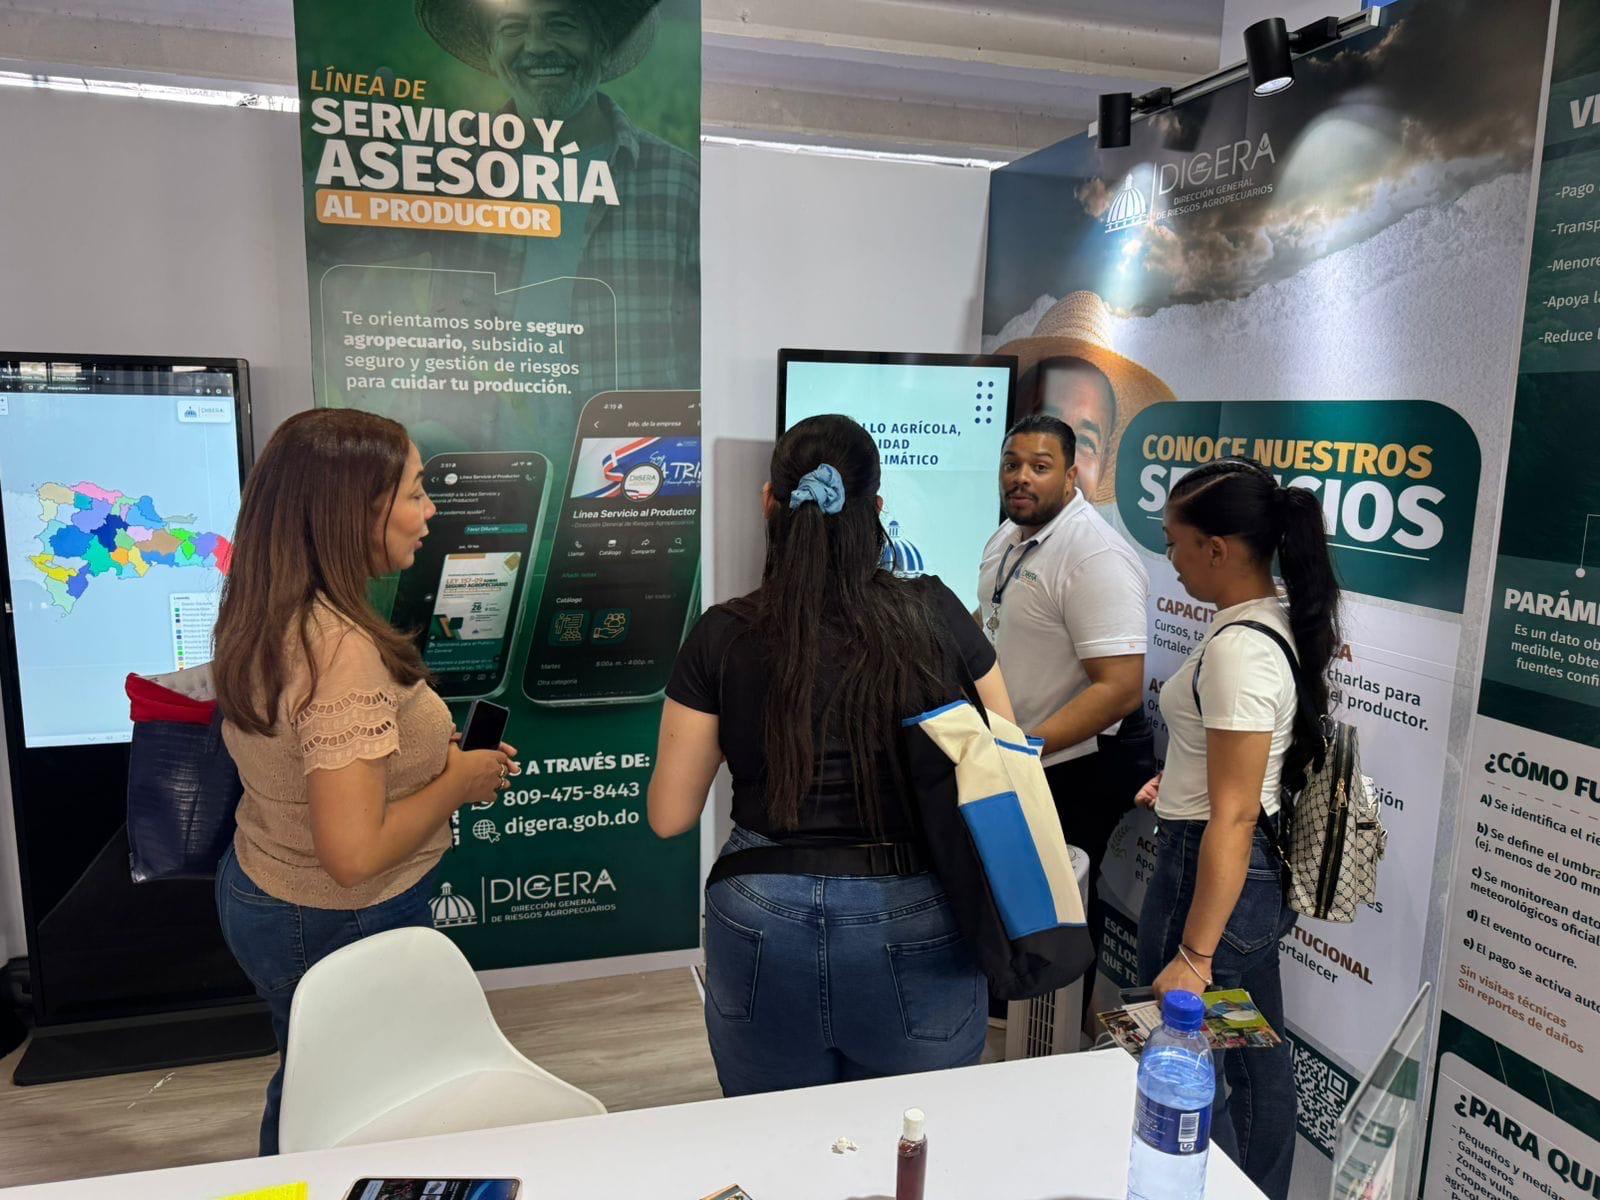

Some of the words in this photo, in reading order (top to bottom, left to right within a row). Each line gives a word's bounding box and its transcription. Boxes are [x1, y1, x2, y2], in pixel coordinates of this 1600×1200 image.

[310, 66, 386, 97] LÍNEA
[394, 78, 427, 100] DE
[311, 97, 526, 150] SERVICIO
[533, 118, 564, 153] Y
[315, 139, 620, 206] ASESORÍA
[1158, 132, 1276, 196] DIGERA
[1156, 210, 1168, 220] DE
[1168, 202, 1201, 217] RIESGOS
[1202, 183, 1274, 209] AGROPECUARIOS
[1173, 187, 1214, 206] DIRECCIÓN
[1216, 178, 1255, 195] GENERAL
[1556, 183, 1594, 199] -Pago
[323, 194, 361, 220] AL
[370, 198, 551, 231] PRODUCTOR
[1542, 293, 1589, 310] -Apoya
[342, 310, 363, 325] Te
[369, 311, 470, 330] orientamos
[474, 317, 522, 332] sobre
[526, 321, 585, 336] seguro
[1538, 329, 1593, 344] -Reduce
[343, 334, 468, 352] agropecuario,
[472, 337, 544, 354] subsidio
[549, 340, 564, 354] al
[344, 354, 405, 371] seguro
[410, 357, 420, 372] y
[425, 355, 489, 373] gestión
[494, 358, 515, 372] de
[520, 358, 580, 377] riesgos
[346, 375, 385, 391] para
[391, 374, 446, 391] cuidar
[451, 377, 469, 391] tu
[474, 378, 572, 395] producción.
[891, 420, 962, 437] AGRÍCOLA,
[880, 452, 939, 465] IMÁTICO
[1142, 434, 1248, 463] CONOCE
[1253, 438, 1434, 479] NUESTROS
[572, 510, 599, 519] Línea
[600, 509, 639, 518] Servicio
[640, 509, 649, 517] al
[650, 508, 697, 517] Productor
[1154, 618, 1191, 641] Cursos,
[1514, 623, 1528, 637] Es
[1531, 629, 1546, 640] un
[1550, 631, 1580, 647] dato
[1511, 641, 1564, 663] medible,
[1516, 657, 1563, 678] fuentes
[1327, 668, 1380, 695] charlas
[1385, 685, 1421, 707] para
[1347, 692, 1429, 732] productor.
[525, 759, 541, 775] A
[544, 751, 618, 774] TRAVÉS
[621, 753, 651, 769] DE:
[1484, 752, 1569, 791] ¿CÓMO
[503, 782, 641, 807] 809-475-8443
[1375, 787, 1404, 811] ión
[504, 808, 640, 837] digera.gob.do
[1480, 794, 1492, 807] A)
[1494, 799, 1508, 811] Se
[1511, 803, 1567, 833] identifica
[1570, 828, 1582, 839] el
[1476, 822, 1489, 836] b)
[1490, 828, 1504, 842] Se
[1507, 835, 1544, 857] define
[1547, 851, 1559, 863] el
[1475, 836, 1492, 852] (ej.
[1494, 846, 1533, 868] menos
[1536, 861, 1552, 876] de
[1554, 868, 1577, 886] 200
[490, 868, 617, 904] DIGERA
[1471, 866, 1482, 879] c)
[1484, 871, 1498, 885] Se
[1501, 879, 1569, 916] monitorean
[491, 915, 504, 923] DE
[505, 911, 543, 922] RIESGOS
[544, 904, 617, 919] AGROPECUARIOS
[510, 900, 557, 913] DIRECCIÓN
[558, 897, 598, 909] GENERAL
[1470, 881, 1558, 928] meteorológicos
[1103, 933, 1117, 951] DE
[1118, 942, 1138, 968] LOS
[1466, 909, 1479, 921] d)
[1480, 915, 1490, 927] El
[1492, 923, 1532, 947] evento
[1534, 941, 1578, 969] ocurre.
[1102, 951, 1123, 971] QUE
[1463, 937, 1475, 950] e)
[1476, 943, 1487, 955] El
[1488, 948, 1516, 970] pago
[1518, 964, 1532, 979] se
[1535, 974, 1571, 998] activa
[1460, 964, 1477, 980] Sin
[1478, 974, 1515, 1001] visitas
[1517, 996, 1567, 1028] técnicas
[1457, 978, 1475, 994] Sin
[1477, 988, 1525, 1022] reportes
[1528, 1015, 1543, 1031] de
[1545, 1025, 1585, 1054] daños
[1454, 1094, 1540, 1161] ¿PARA
[1456, 1153, 1487, 1181] Zonas
[1457, 1140, 1514, 1186] Ganaderos
[1459, 1126, 1510, 1169] Pequeños
[1513, 1163, 1520, 1175] y
